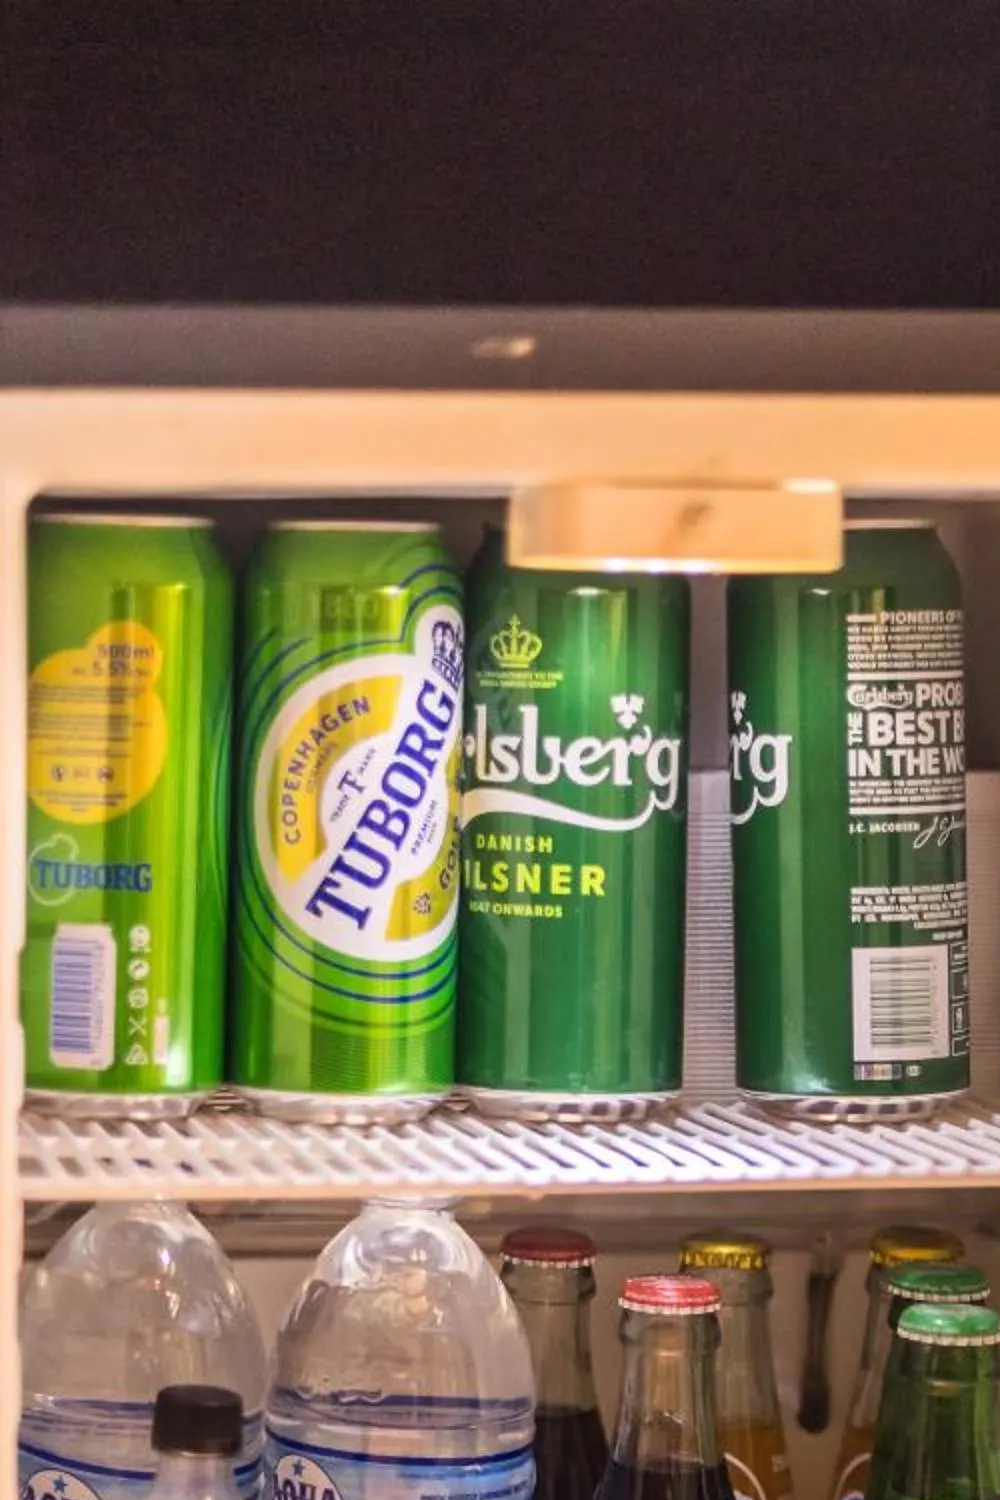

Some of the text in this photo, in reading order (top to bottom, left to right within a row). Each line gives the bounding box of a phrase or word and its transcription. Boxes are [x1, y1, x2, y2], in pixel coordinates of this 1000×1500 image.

[847, 681, 964, 710] Carlsberg PROB
[847, 712, 863, 746] THE
[868, 711, 950, 746] BEST
[282, 696, 370, 845] COPENHAGEN
[463, 703, 681, 812] lsberg
[848, 749, 881, 777] IN
[885, 748, 941, 776] THE
[305, 680, 455, 931] TUBORG
[476, 834, 553, 853] DANISH
[36, 860, 153, 893] TUBORG
[464, 860, 606, 896] ILSNER
[493, 903, 563, 919] ONWARDS
